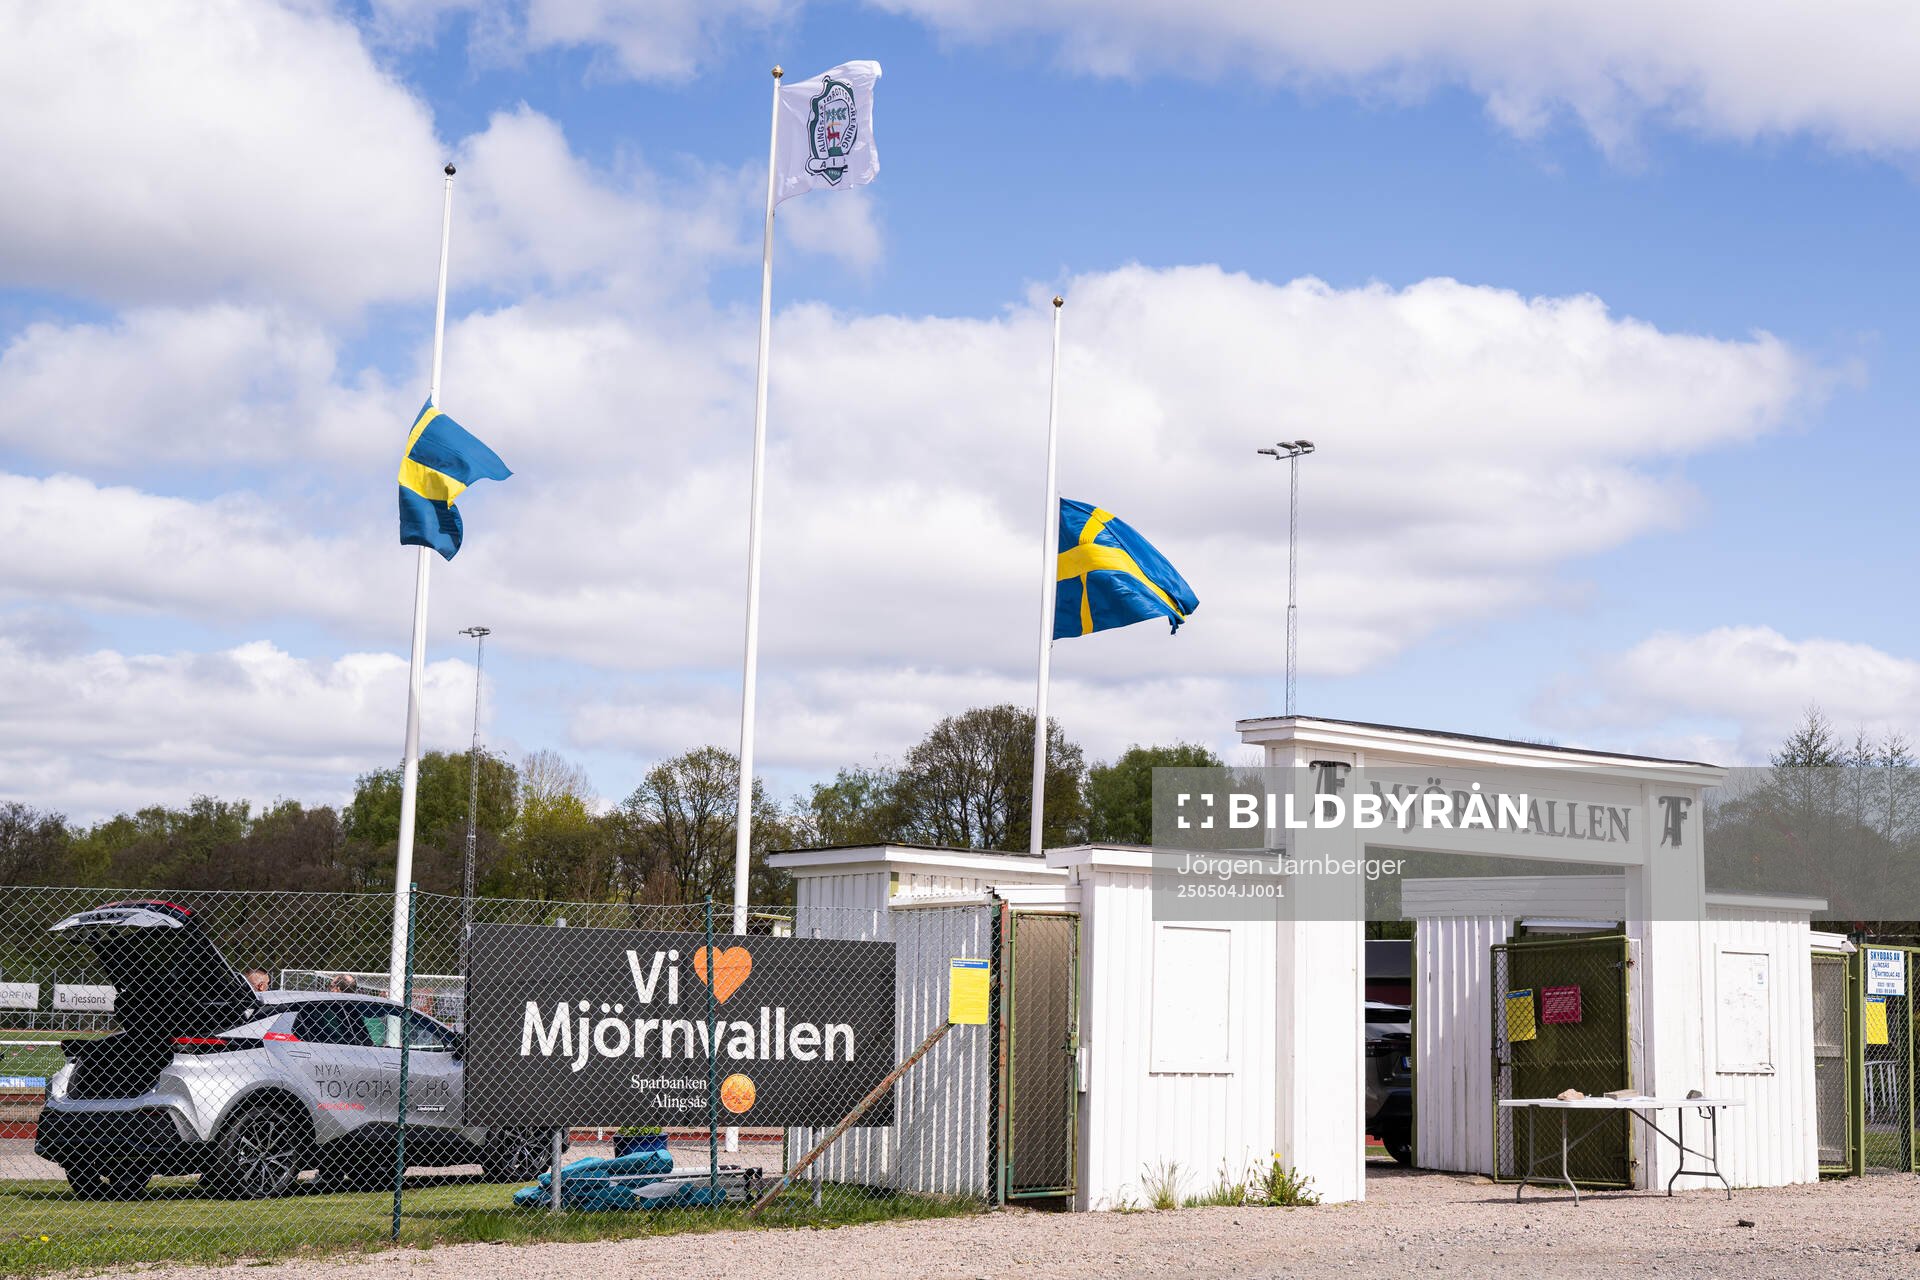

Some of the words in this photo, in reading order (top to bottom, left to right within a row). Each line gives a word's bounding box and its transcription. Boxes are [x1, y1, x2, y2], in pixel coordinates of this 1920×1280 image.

[626, 949, 680, 1005] Vi
[60, 992, 106, 1006] Brjessons
[520, 1001, 855, 1072] Mjörnvallen
[315, 1064, 341, 1076] NYA
[316, 1080, 393, 1098] TOYOTA
[631, 1073, 707, 1093] Sparbanken
[651, 1094, 707, 1112] Alingsås
